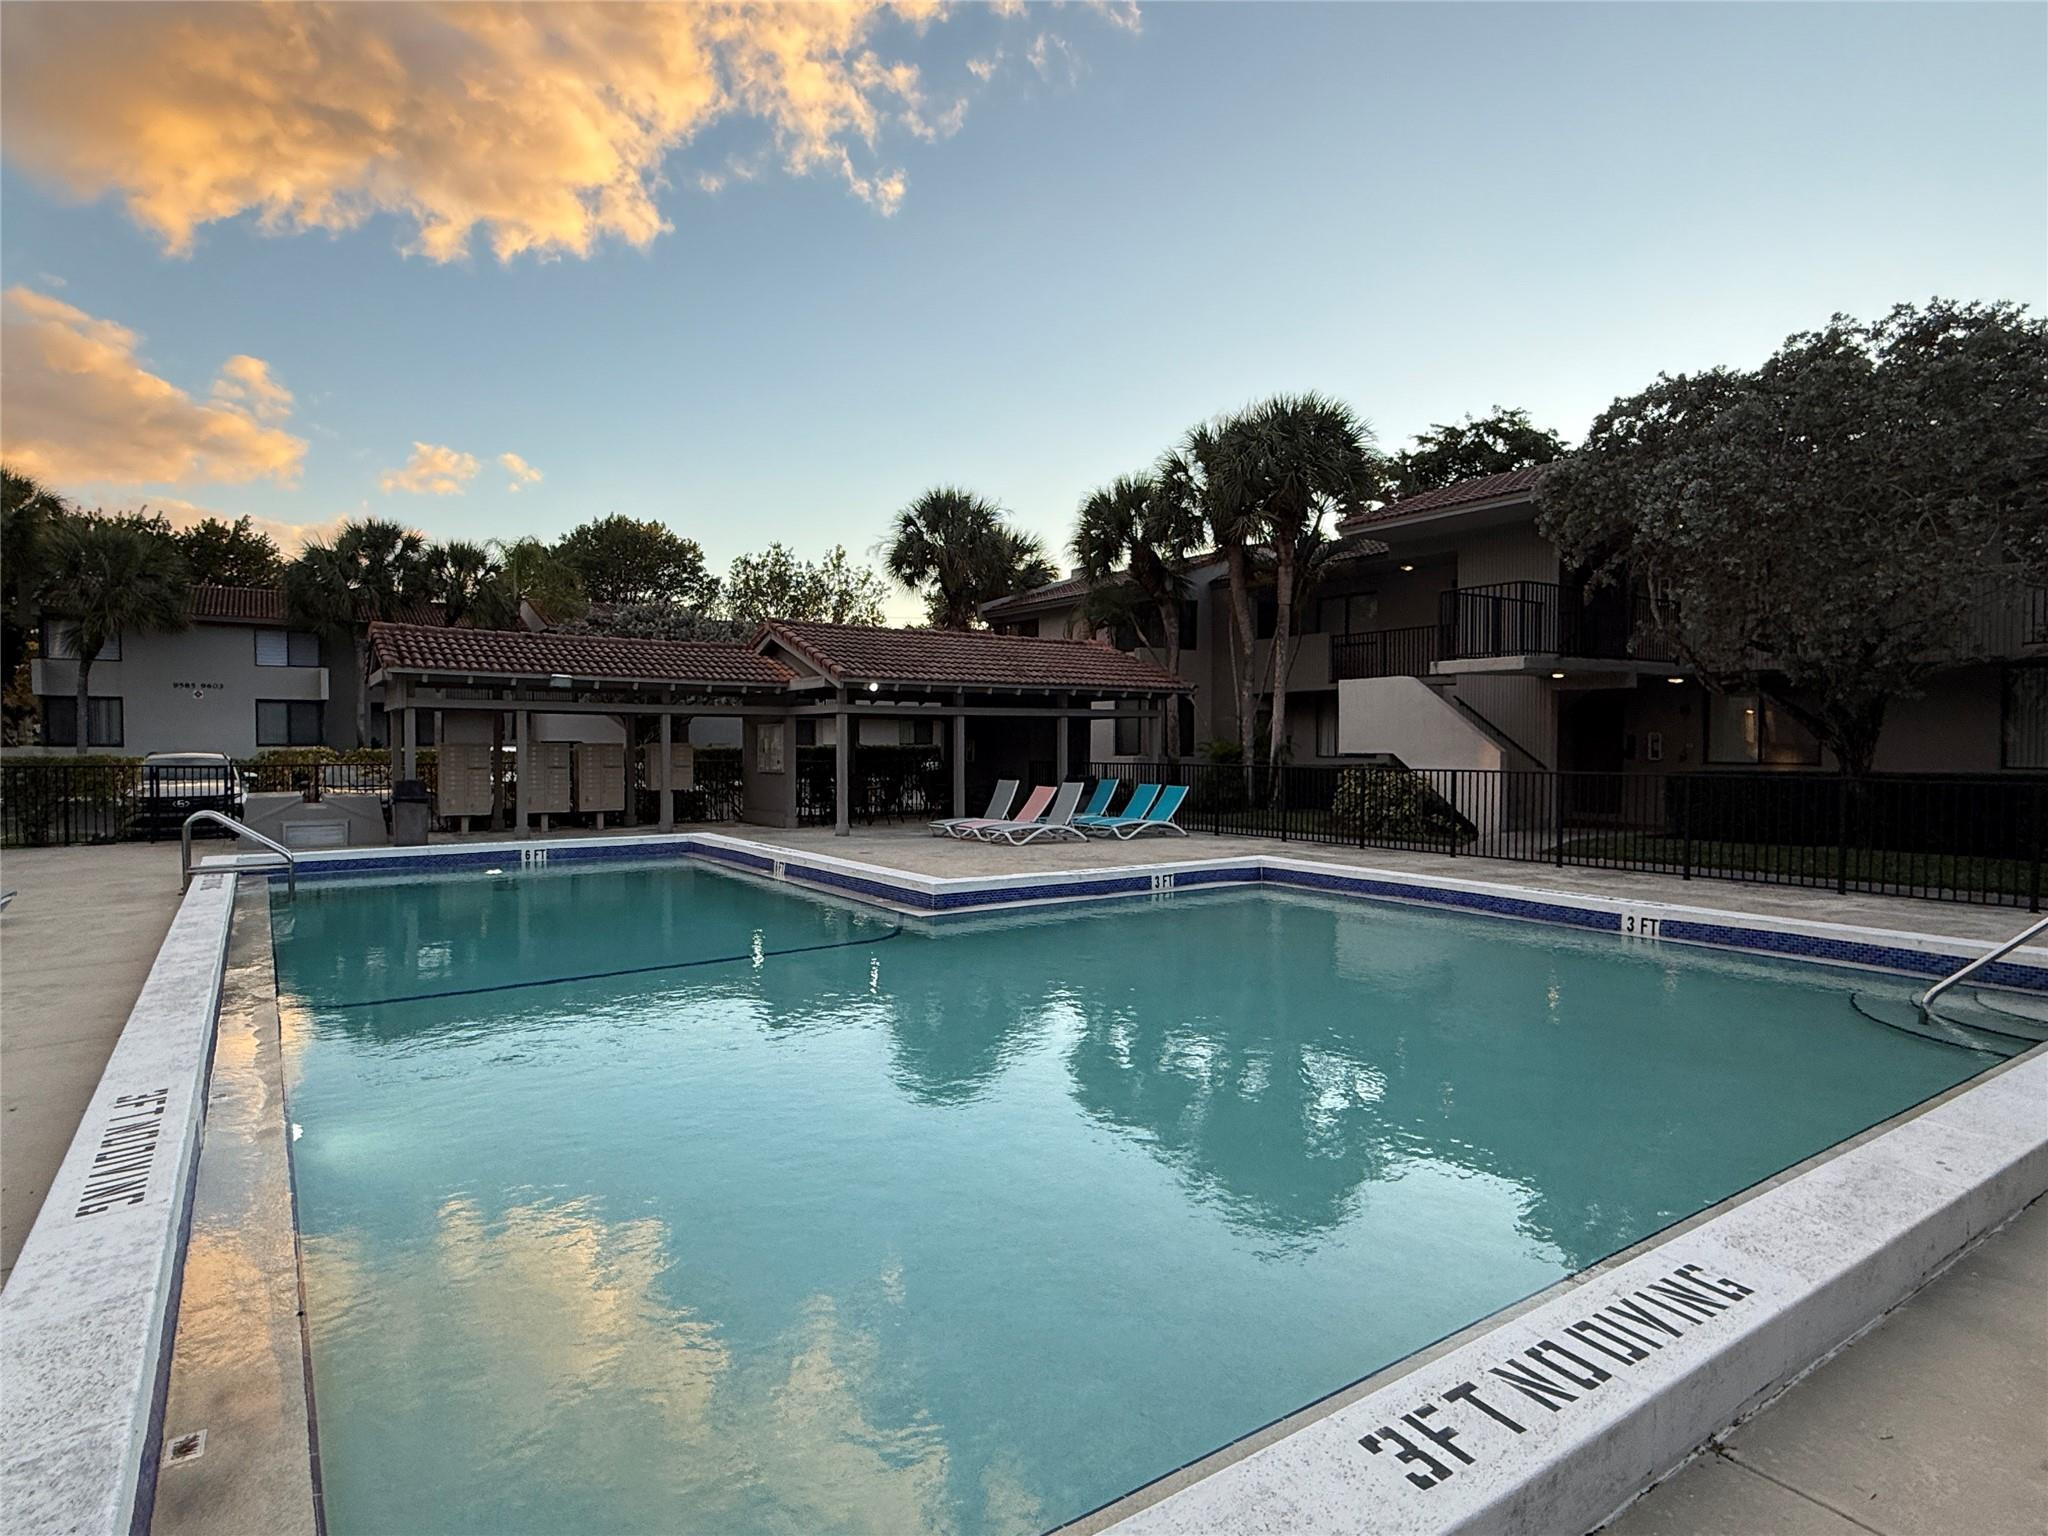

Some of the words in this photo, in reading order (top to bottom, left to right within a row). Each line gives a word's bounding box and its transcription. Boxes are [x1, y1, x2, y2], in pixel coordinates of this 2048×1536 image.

[525, 849, 531, 860] 6
[534, 849, 546, 860] FT
[1154, 875, 1160, 888] 3
[1162, 874, 1173, 888] FT
[1626, 916, 1635, 932] 3
[1640, 917, 1659, 936] FT
[1488, 1339, 1613, 1412] NO
[1563, 1263, 1755, 1366] DIVING
